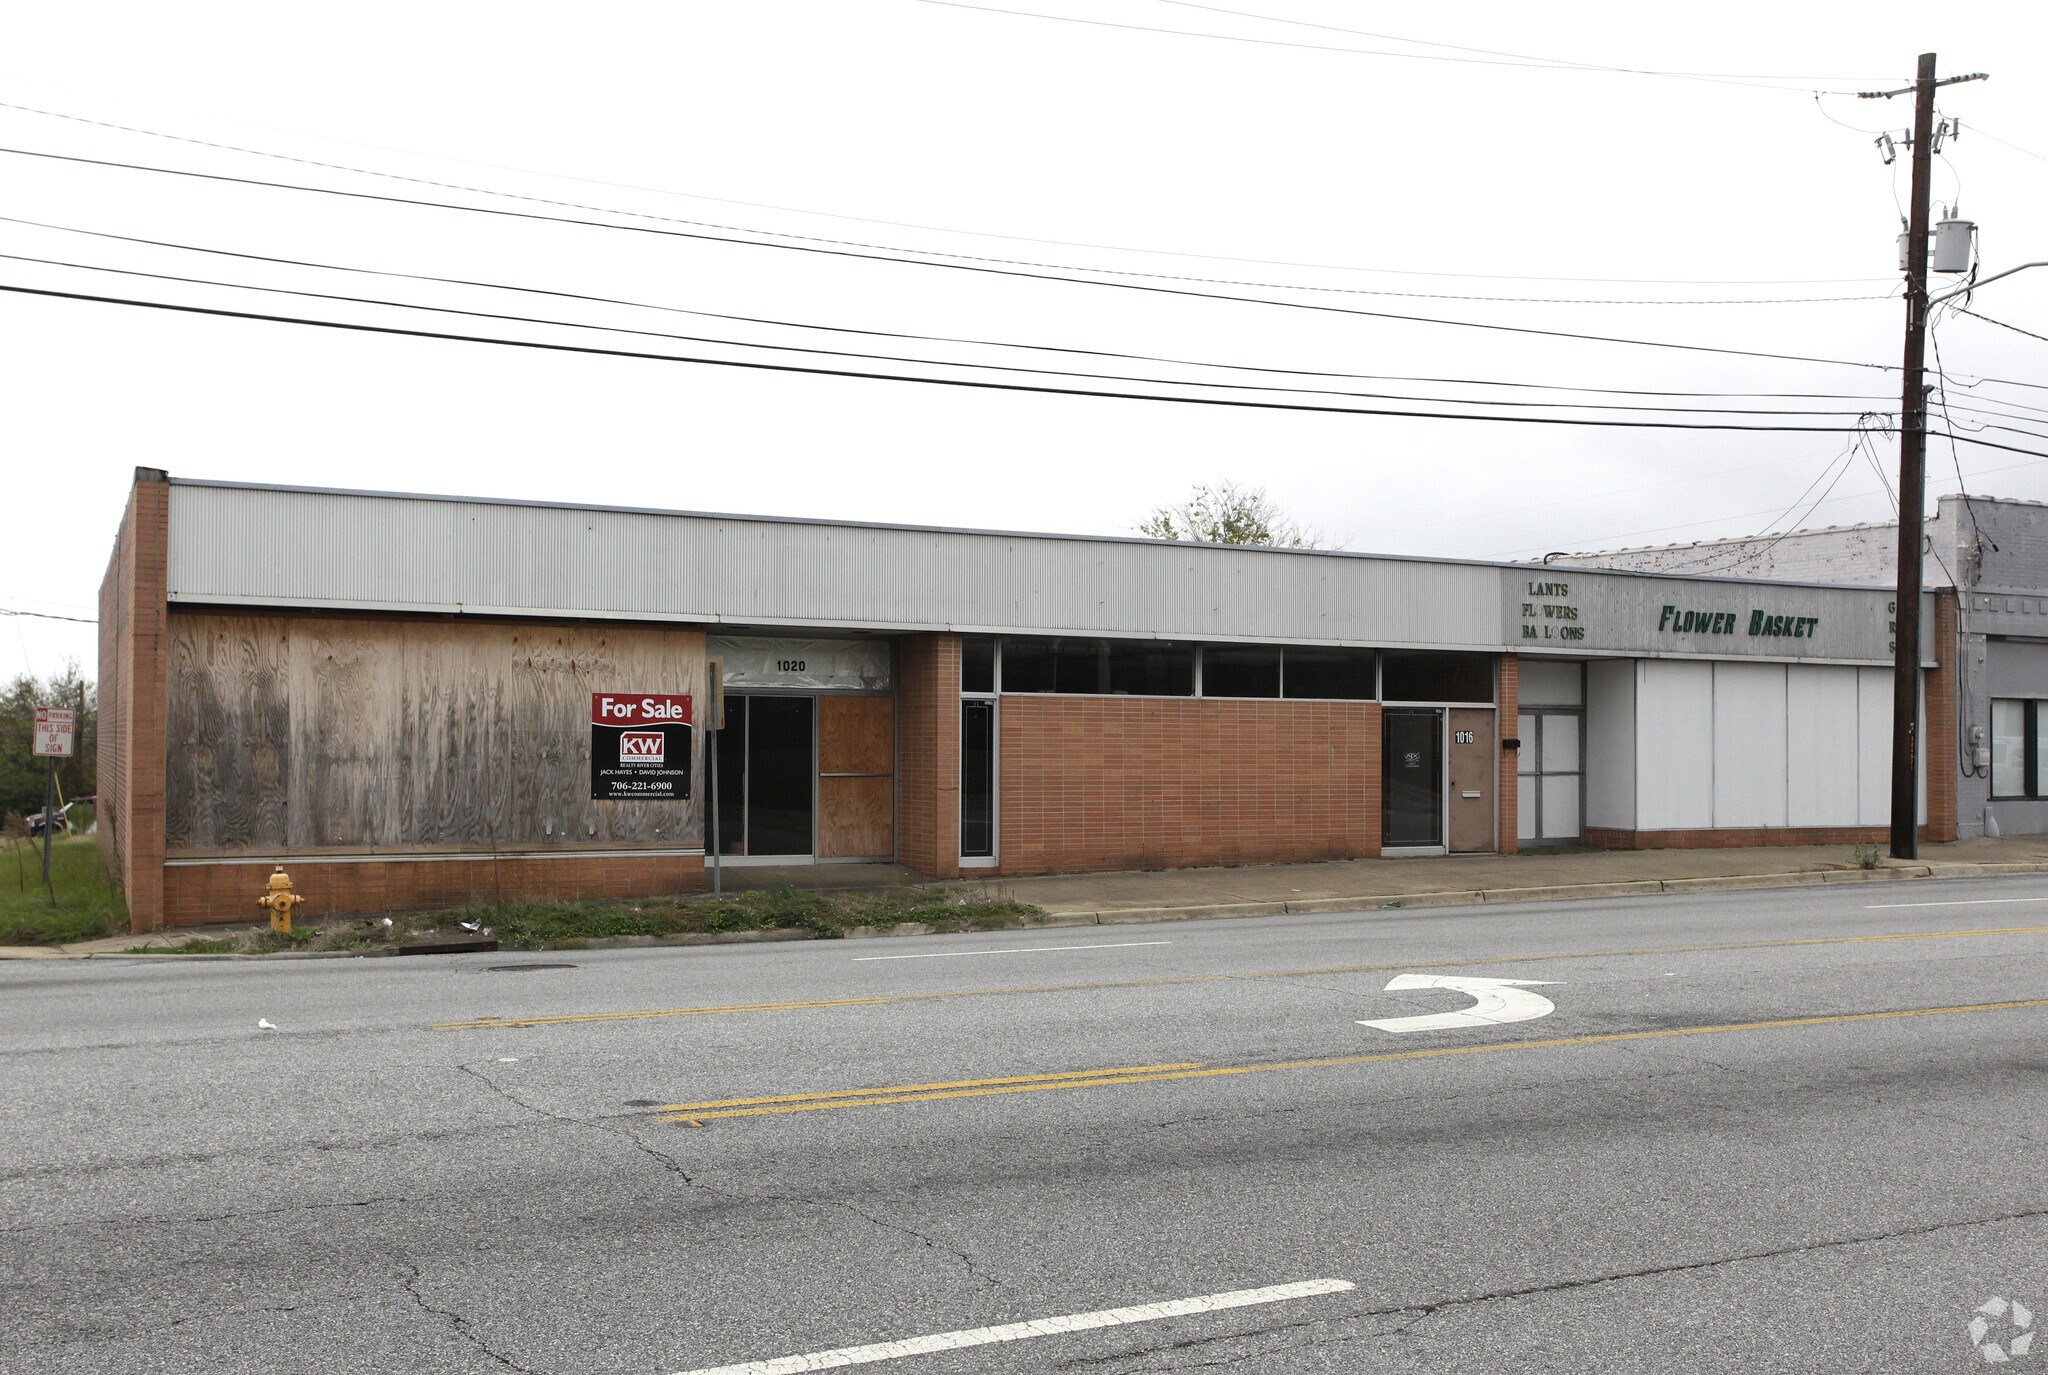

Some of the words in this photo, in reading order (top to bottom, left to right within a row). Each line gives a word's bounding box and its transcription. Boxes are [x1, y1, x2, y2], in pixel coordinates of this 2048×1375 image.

[1521, 603, 1578, 621] FLWERS
[1658, 605, 1737, 635] FLOWER
[1748, 609, 1819, 638] BASKET
[777, 660, 805, 671] 1020
[601, 697, 637, 718] For
[641, 698, 683, 719] Sale
[37, 710, 46, 720] NO
[48, 712, 73, 720] PARKING
[38, 724, 53, 733] THIS
[56, 724, 72, 734] SIDE
[49, 734, 58, 742] OF
[1455, 731, 1474, 744] 1016
[45, 744, 62, 752] SIGN
[622, 737, 662, 754] KW
[611, 781, 673, 790] 706-221-6900
